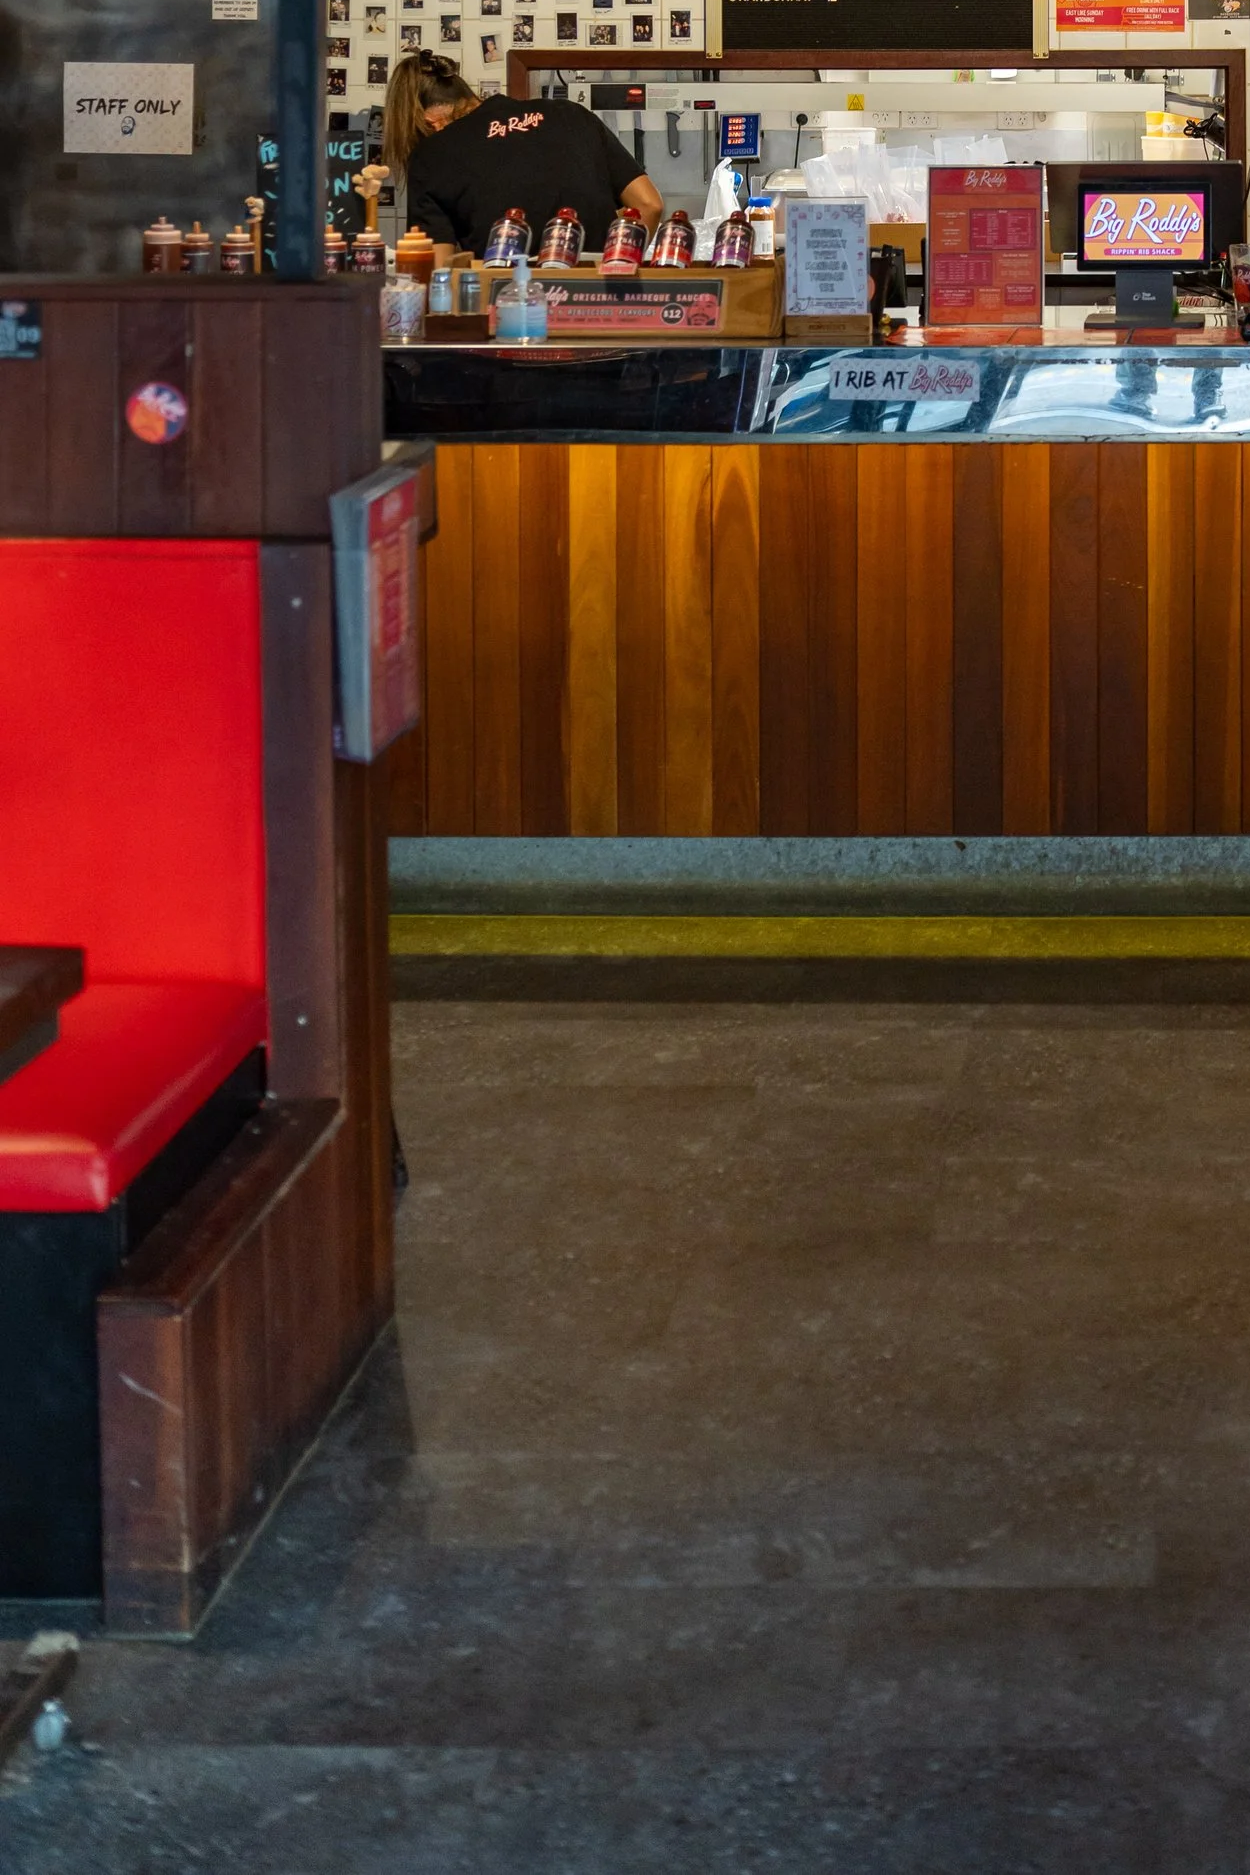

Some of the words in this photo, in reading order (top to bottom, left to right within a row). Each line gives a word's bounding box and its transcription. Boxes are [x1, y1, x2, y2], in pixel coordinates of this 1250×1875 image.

[76, 98, 129, 115] STAFF
[134, 99, 181, 116] ONLY
[487, 120, 506, 138] Big
[508, 112, 544, 132] Roddy's
[1084, 197, 1125, 244] Big
[1126, 197, 1201, 244] Roddy's
[846, 370, 876, 389] RIB
[882, 371, 909, 390] AT
